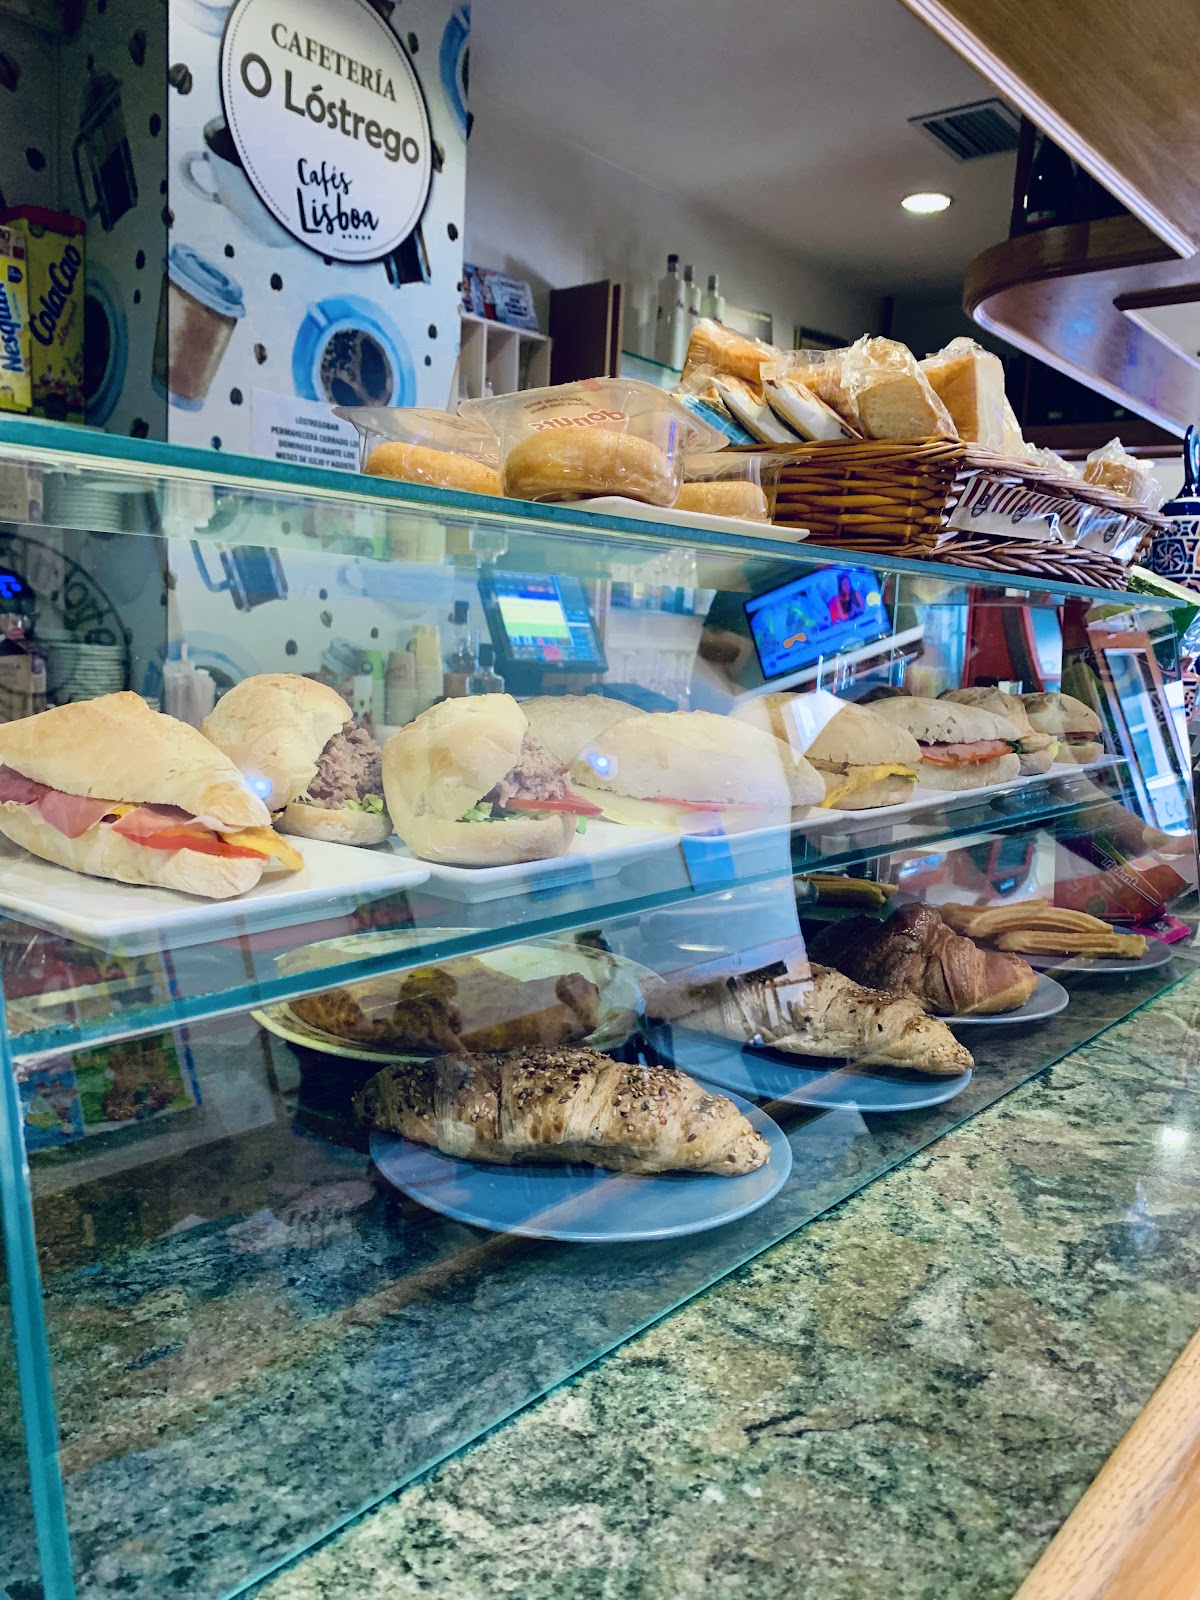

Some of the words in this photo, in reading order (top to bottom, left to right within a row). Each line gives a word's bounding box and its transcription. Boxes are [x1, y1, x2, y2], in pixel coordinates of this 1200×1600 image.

[270, 22, 397, 102] CAFETERÍA
[240, 52, 272, 98] O
[284, 69, 420, 164] Lóstrego
[297, 158, 352, 196] Cafés
[297, 187, 379, 235] Lisboa
[313, 446, 342, 458] DURANTE
[1100, 857, 1140, 886] Trident
